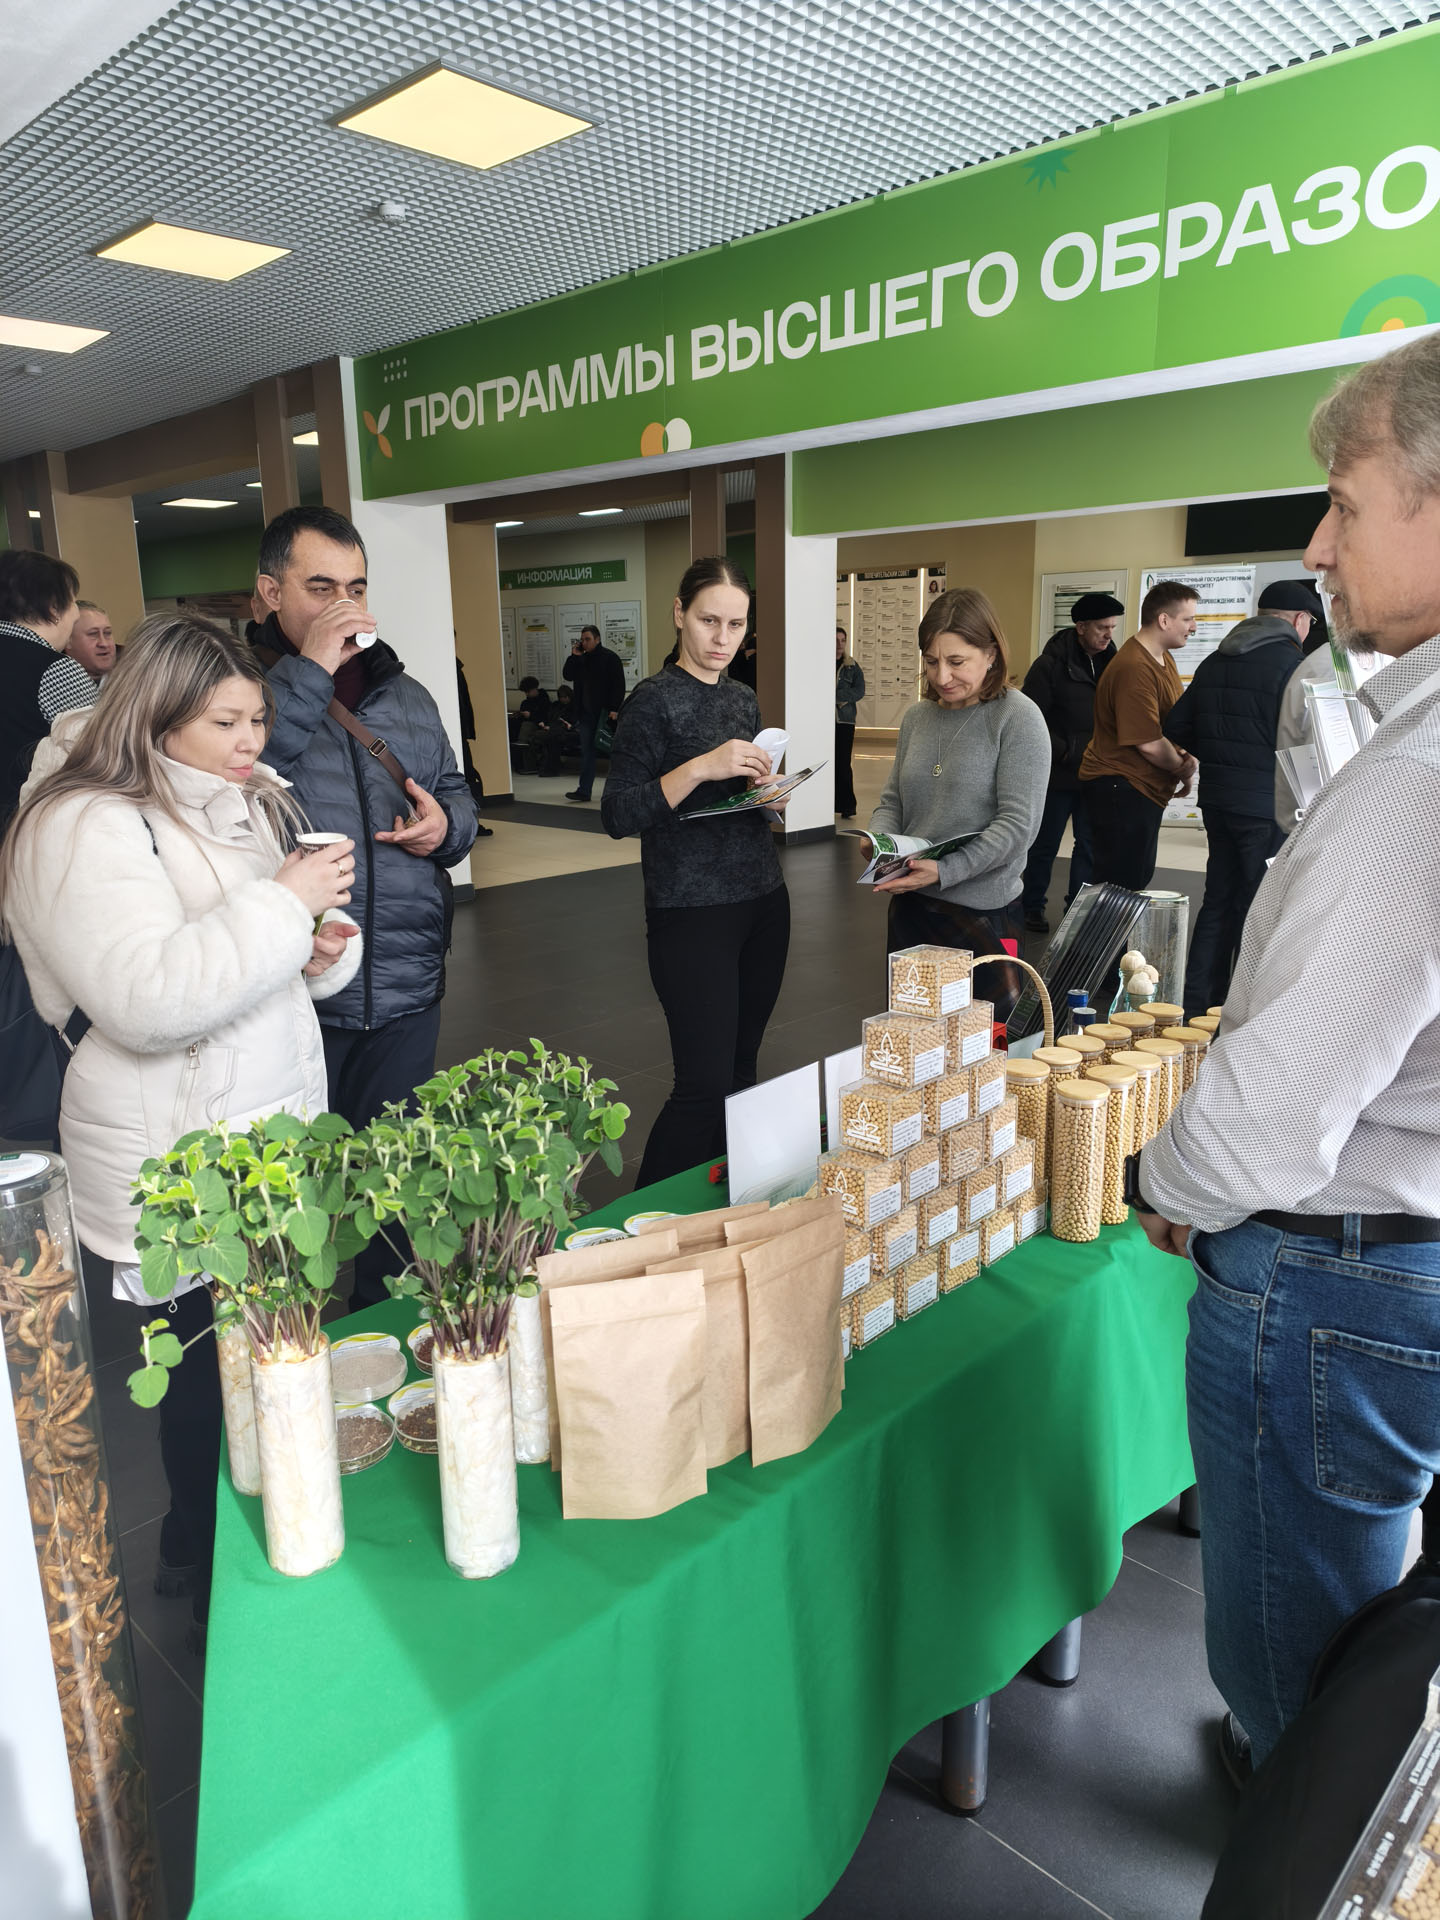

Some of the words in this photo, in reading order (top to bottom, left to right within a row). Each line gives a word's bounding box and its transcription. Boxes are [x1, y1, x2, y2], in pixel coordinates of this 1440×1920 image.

[404, 334, 675, 441] ПРОГРАММЫ
[691, 251, 1019, 381] ВЫСШЕГО
[1040, 144, 1440, 302] ОБРАЗО
[517, 567, 592, 584] ИНФОРМАЦИЯ
